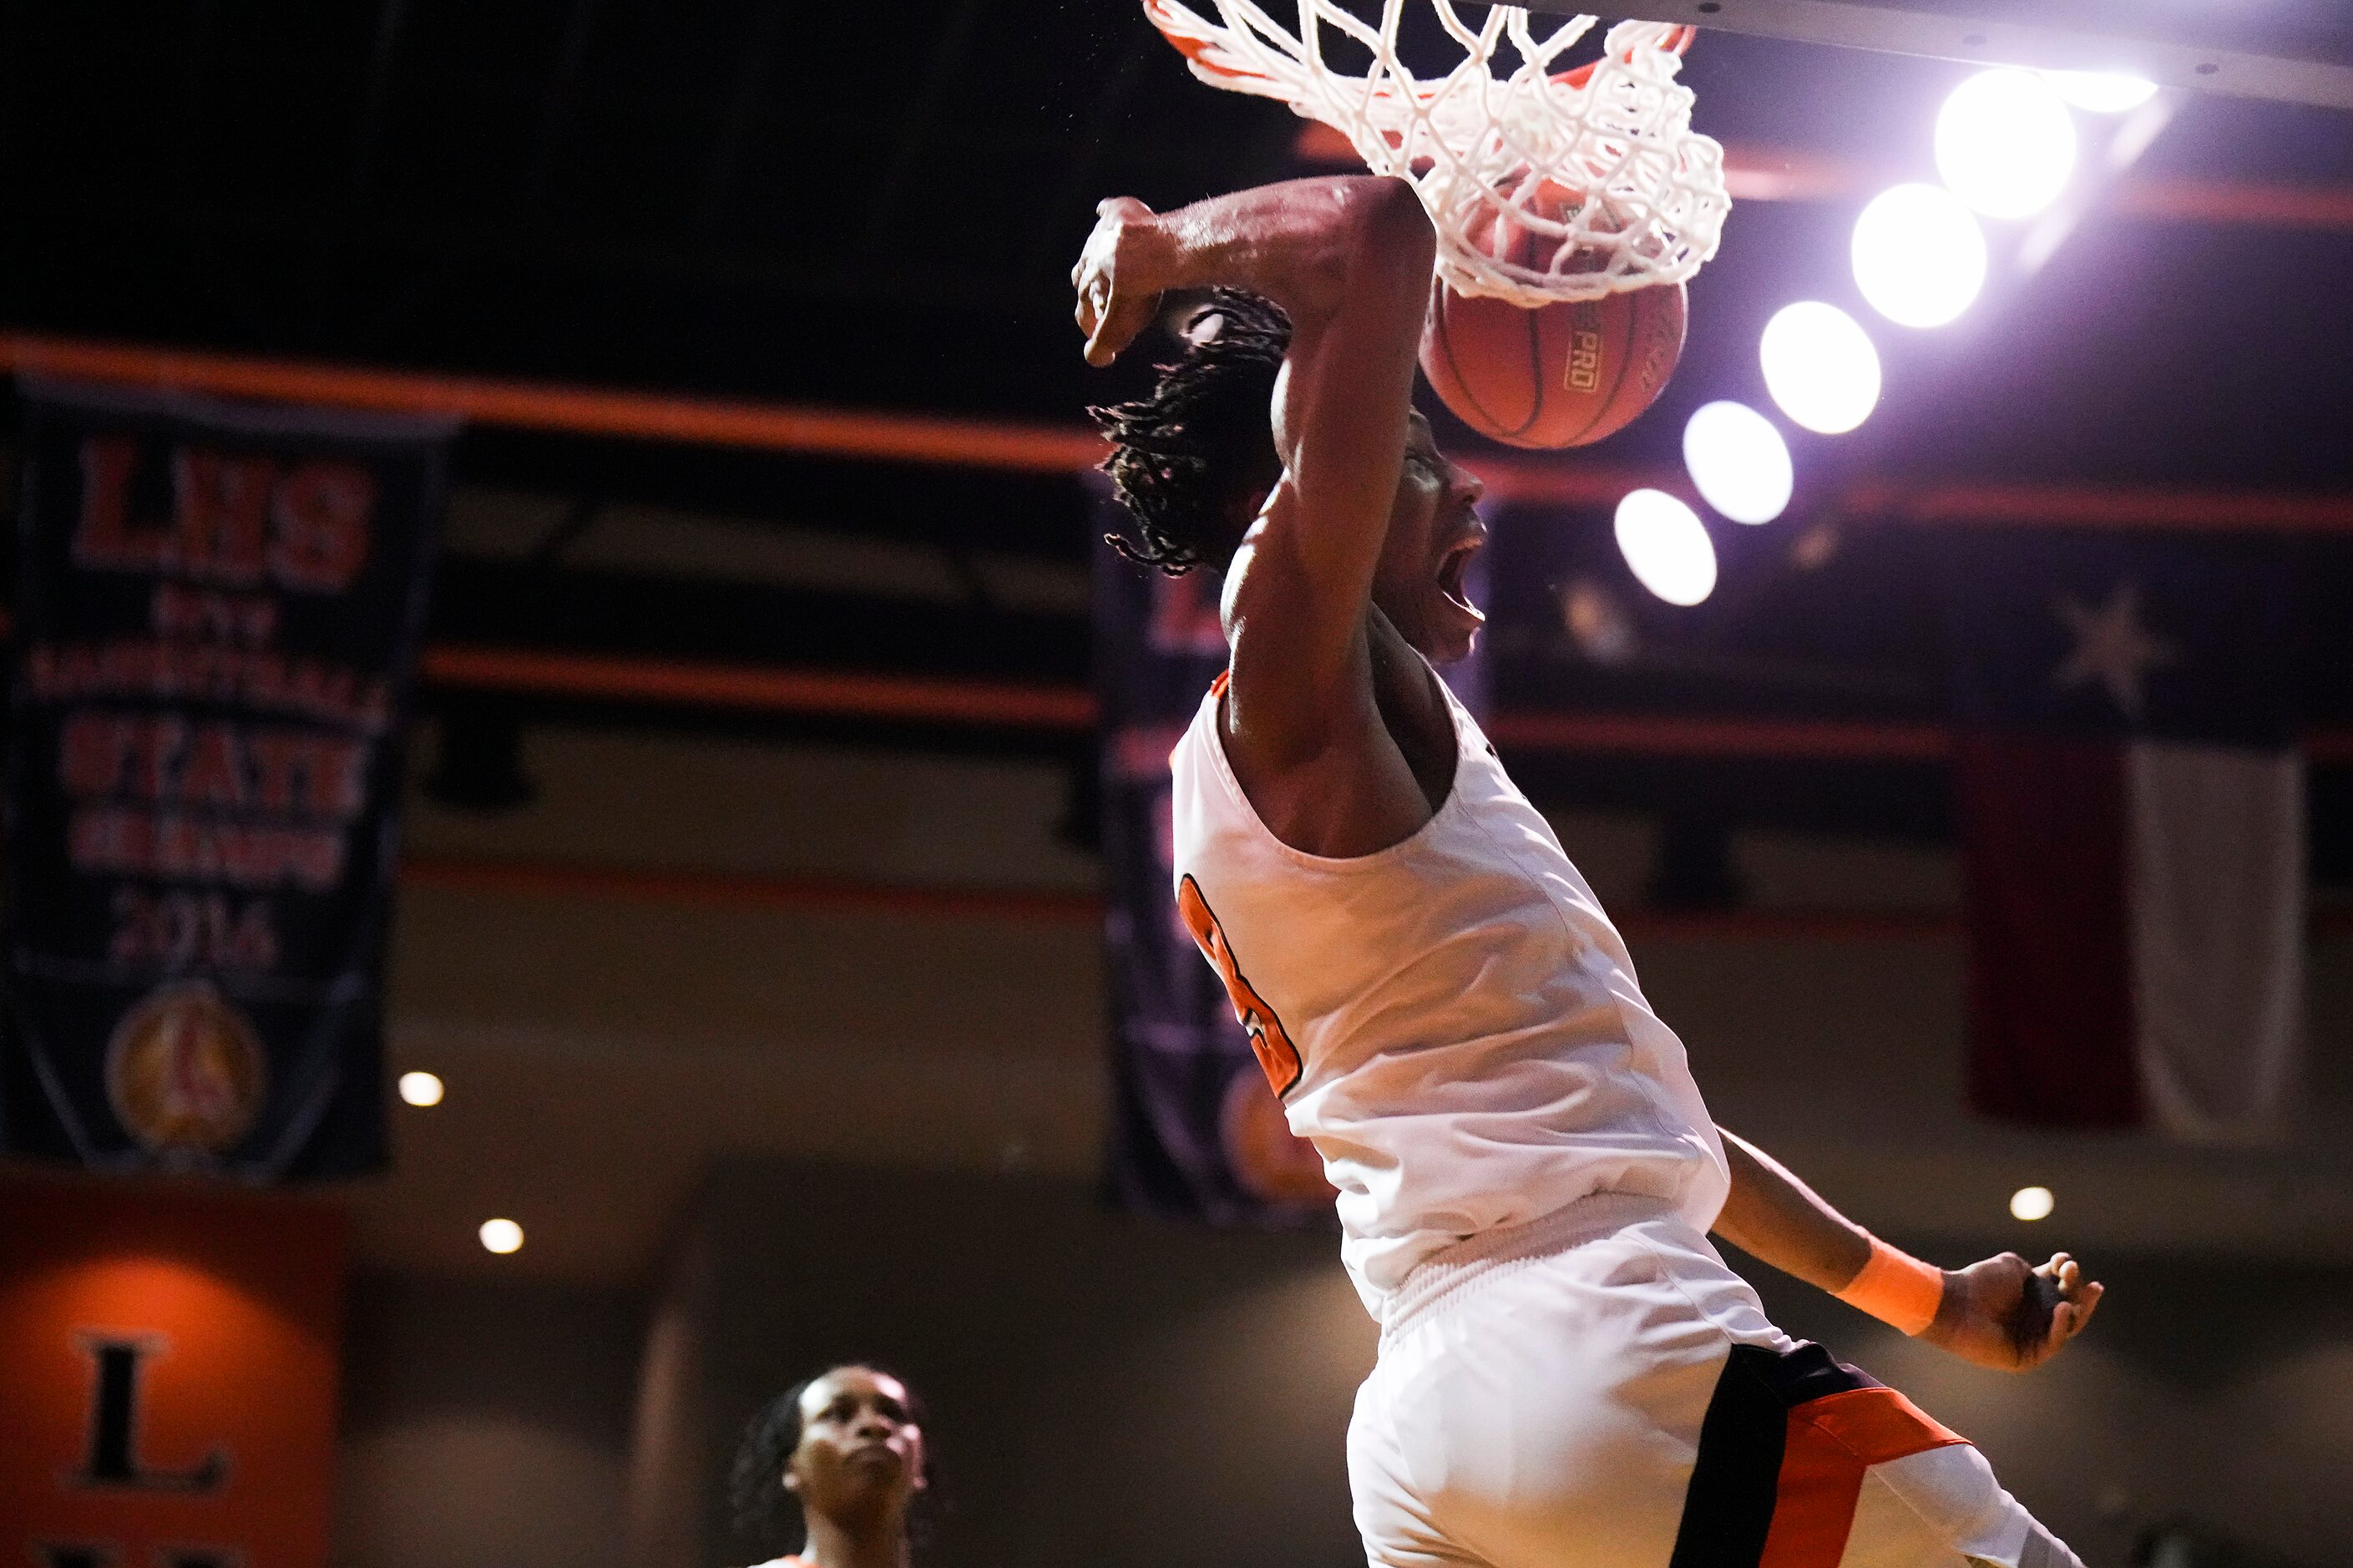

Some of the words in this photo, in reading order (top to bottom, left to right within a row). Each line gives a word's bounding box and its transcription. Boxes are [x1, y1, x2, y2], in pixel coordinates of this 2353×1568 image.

[1570, 331, 1599, 387] PRO
[72, 430, 382, 594] LHS
[59, 710, 370, 822] STATE
[52, 1324, 239, 1496] L
